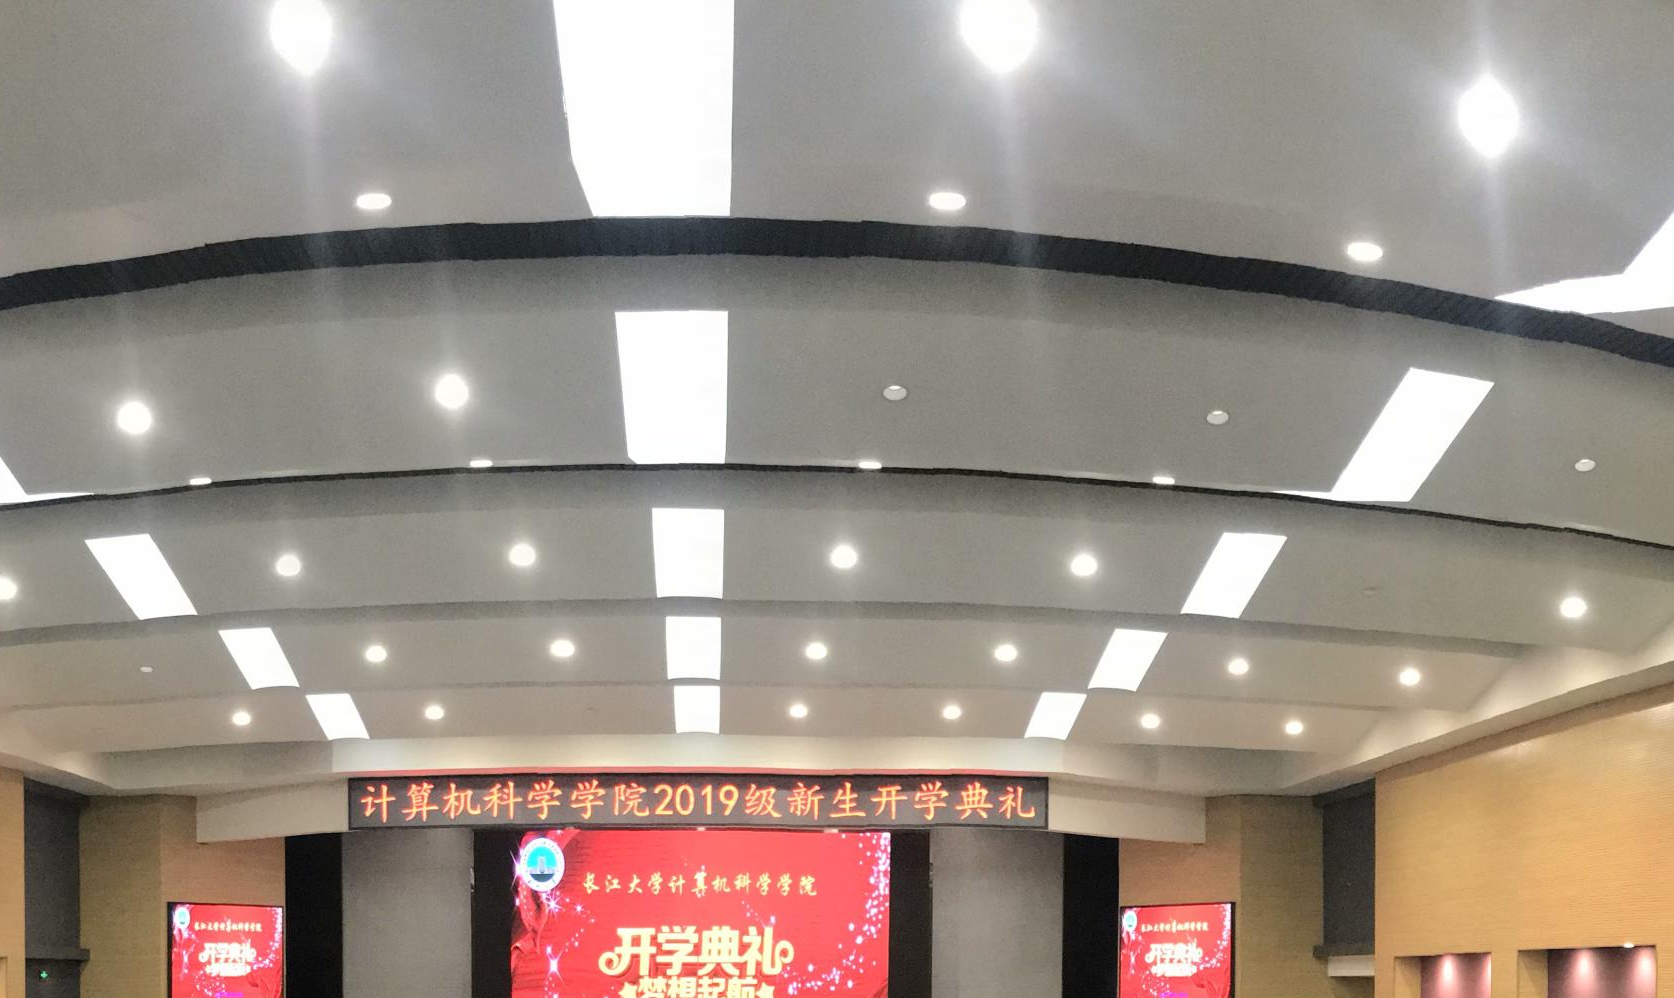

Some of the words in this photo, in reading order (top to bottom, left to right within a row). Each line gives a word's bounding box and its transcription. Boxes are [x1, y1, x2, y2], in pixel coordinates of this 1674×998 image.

[361, 780, 1036, 822] 计算机科学学院2019级新生开学典礼
[583, 872, 817, 897] 长江大学计算机科学学院
[598, 926, 794, 976] 开学典礼
